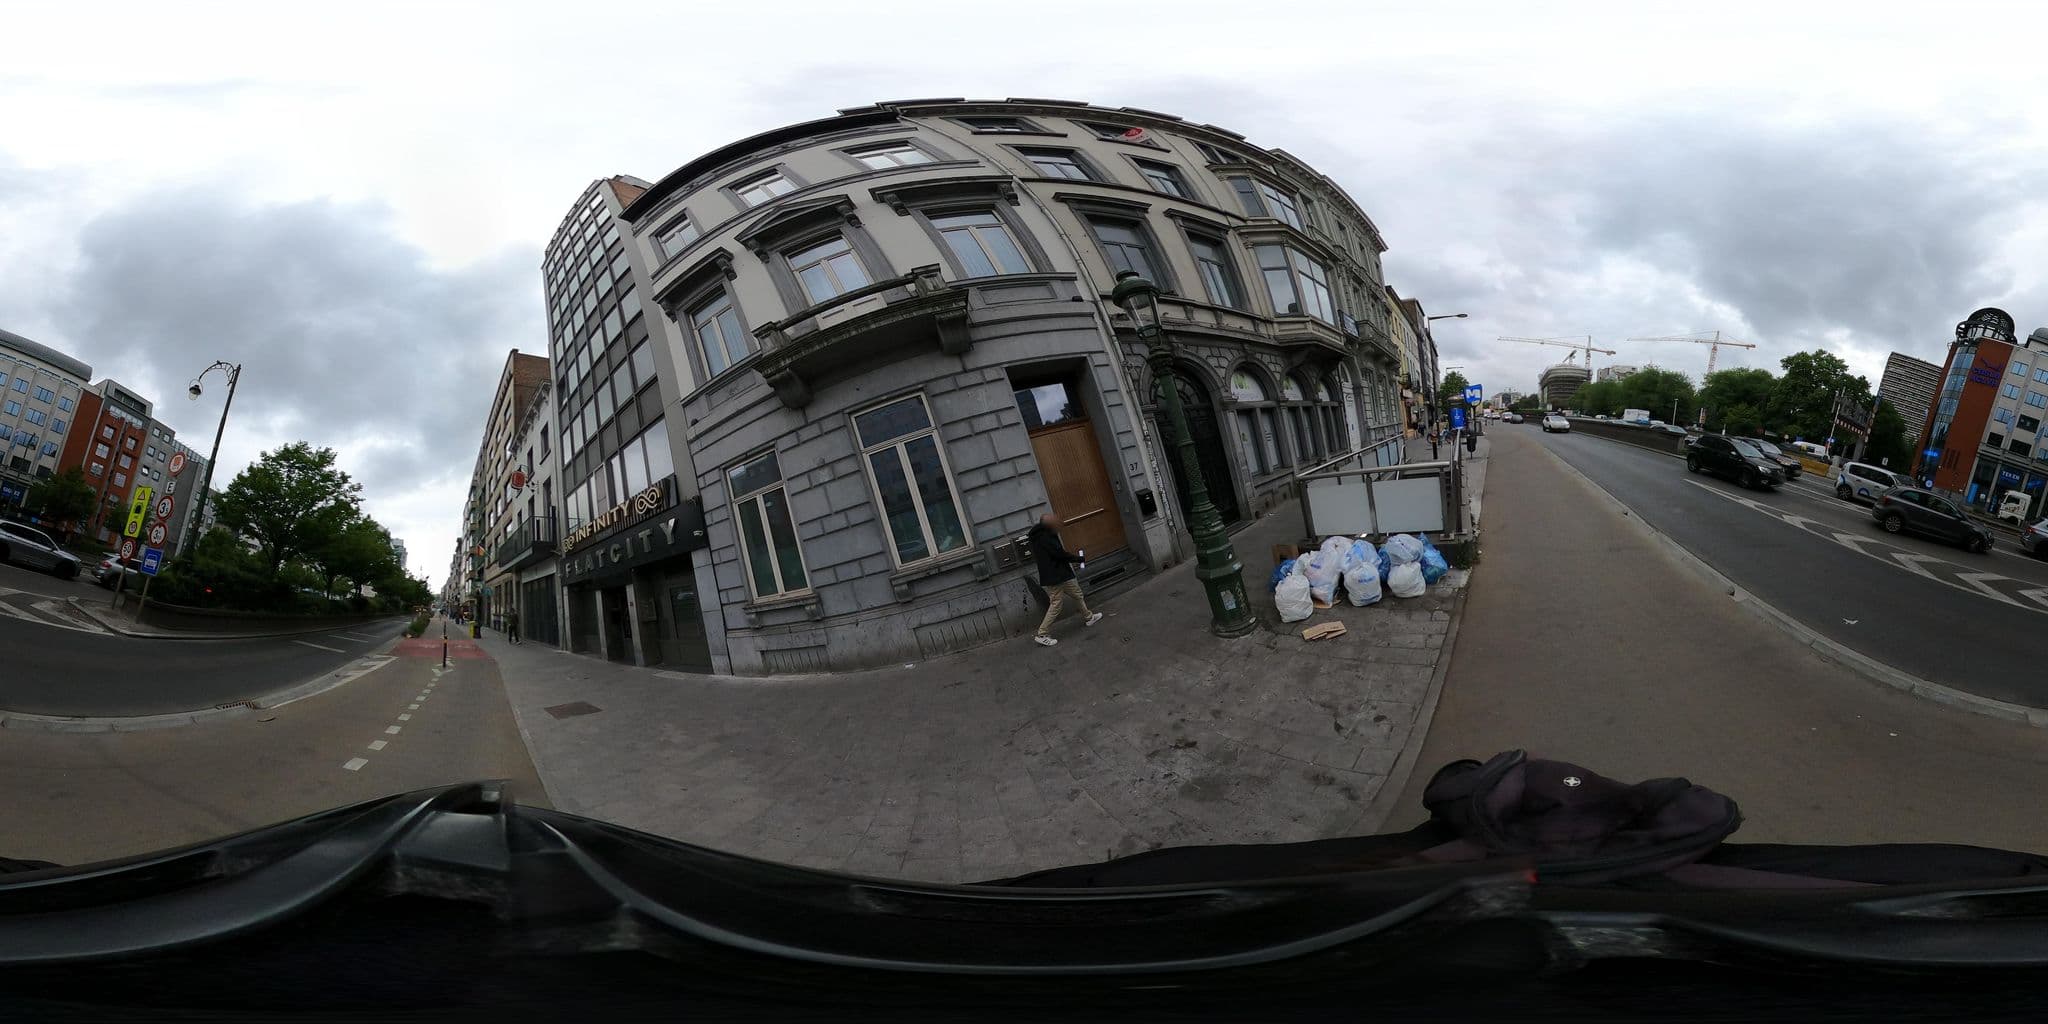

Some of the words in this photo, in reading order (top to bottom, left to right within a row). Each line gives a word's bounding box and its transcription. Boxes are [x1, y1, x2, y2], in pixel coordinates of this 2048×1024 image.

[1465, 388, 1481, 399] M
[1129, 462, 1138, 471] 37
[167, 482, 174, 492] E
[575, 500, 630, 543] INFINITY
[564, 517, 676, 578] FLATCITY
